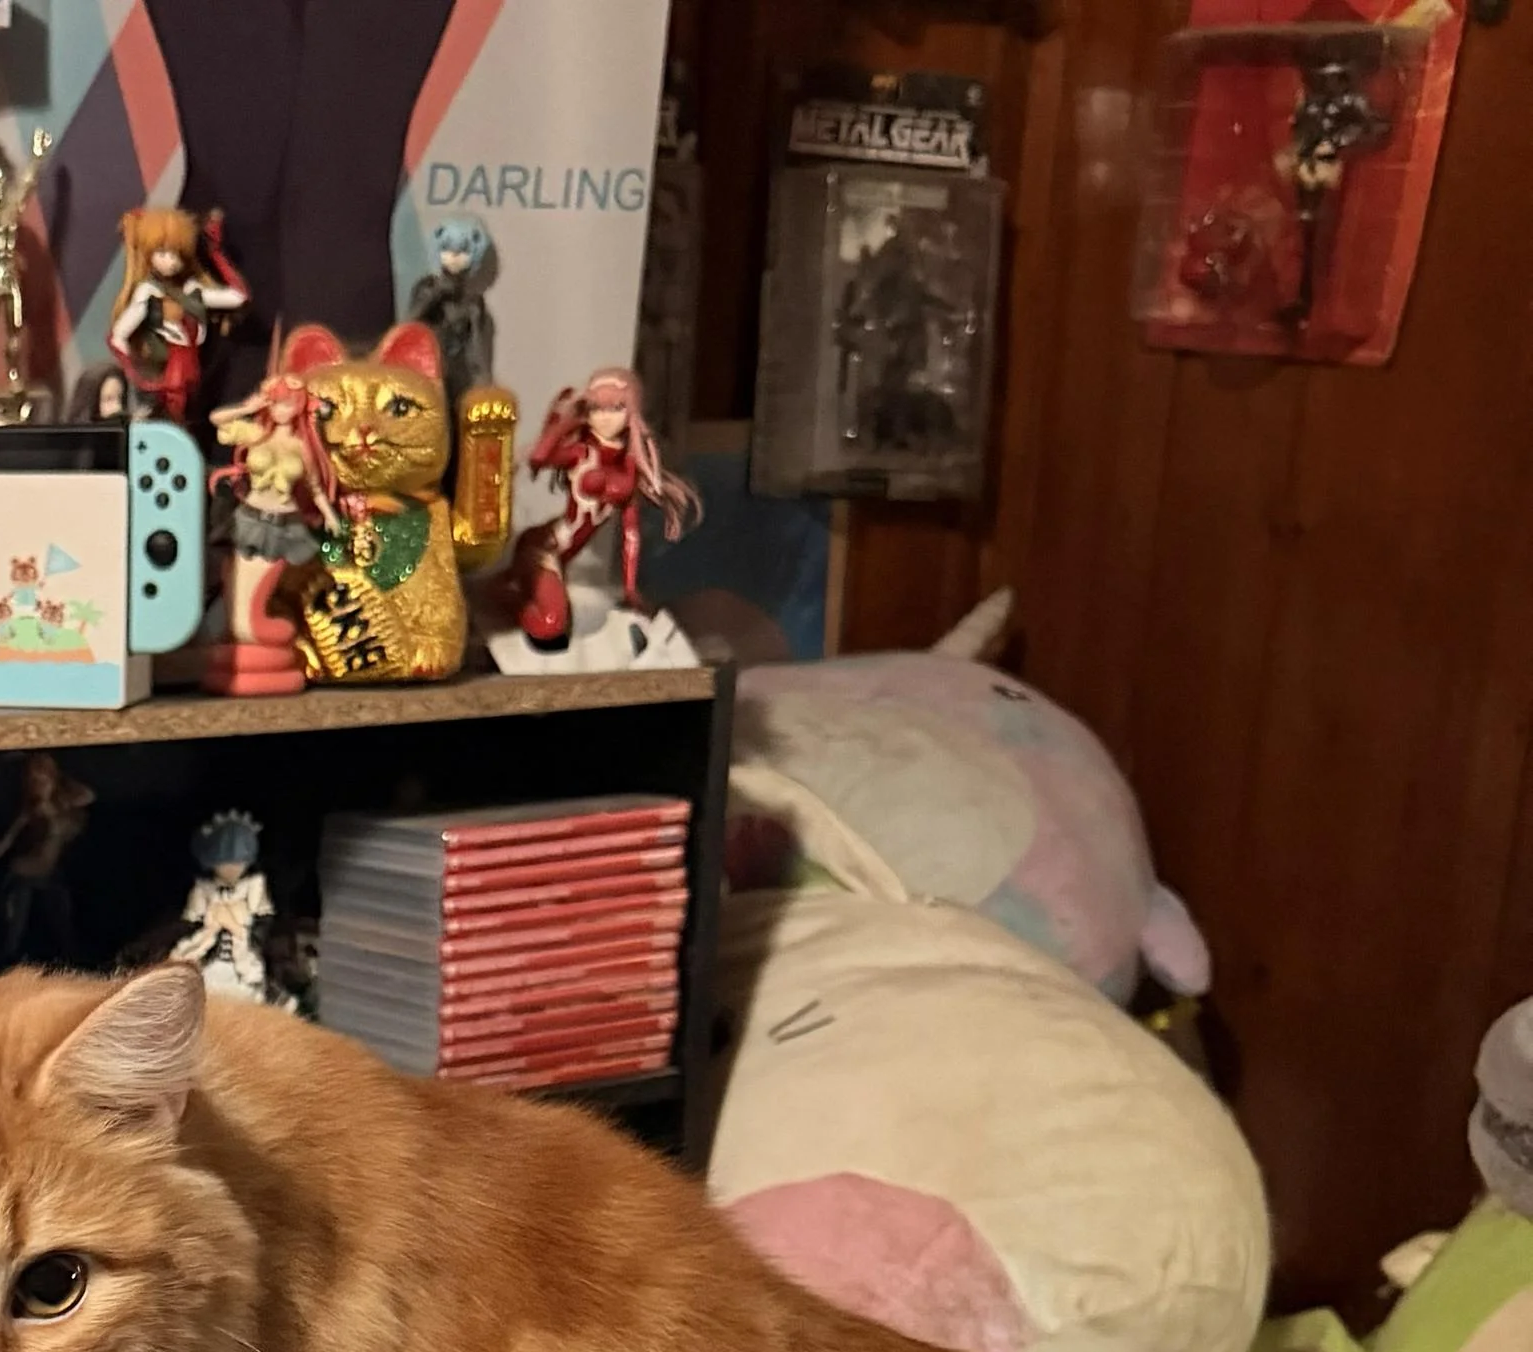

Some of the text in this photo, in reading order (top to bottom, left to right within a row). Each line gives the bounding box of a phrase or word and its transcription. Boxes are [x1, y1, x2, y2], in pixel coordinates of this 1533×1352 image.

[797, 107, 975, 158] METAL GEAR
[426, 162, 646, 212] DARLING
